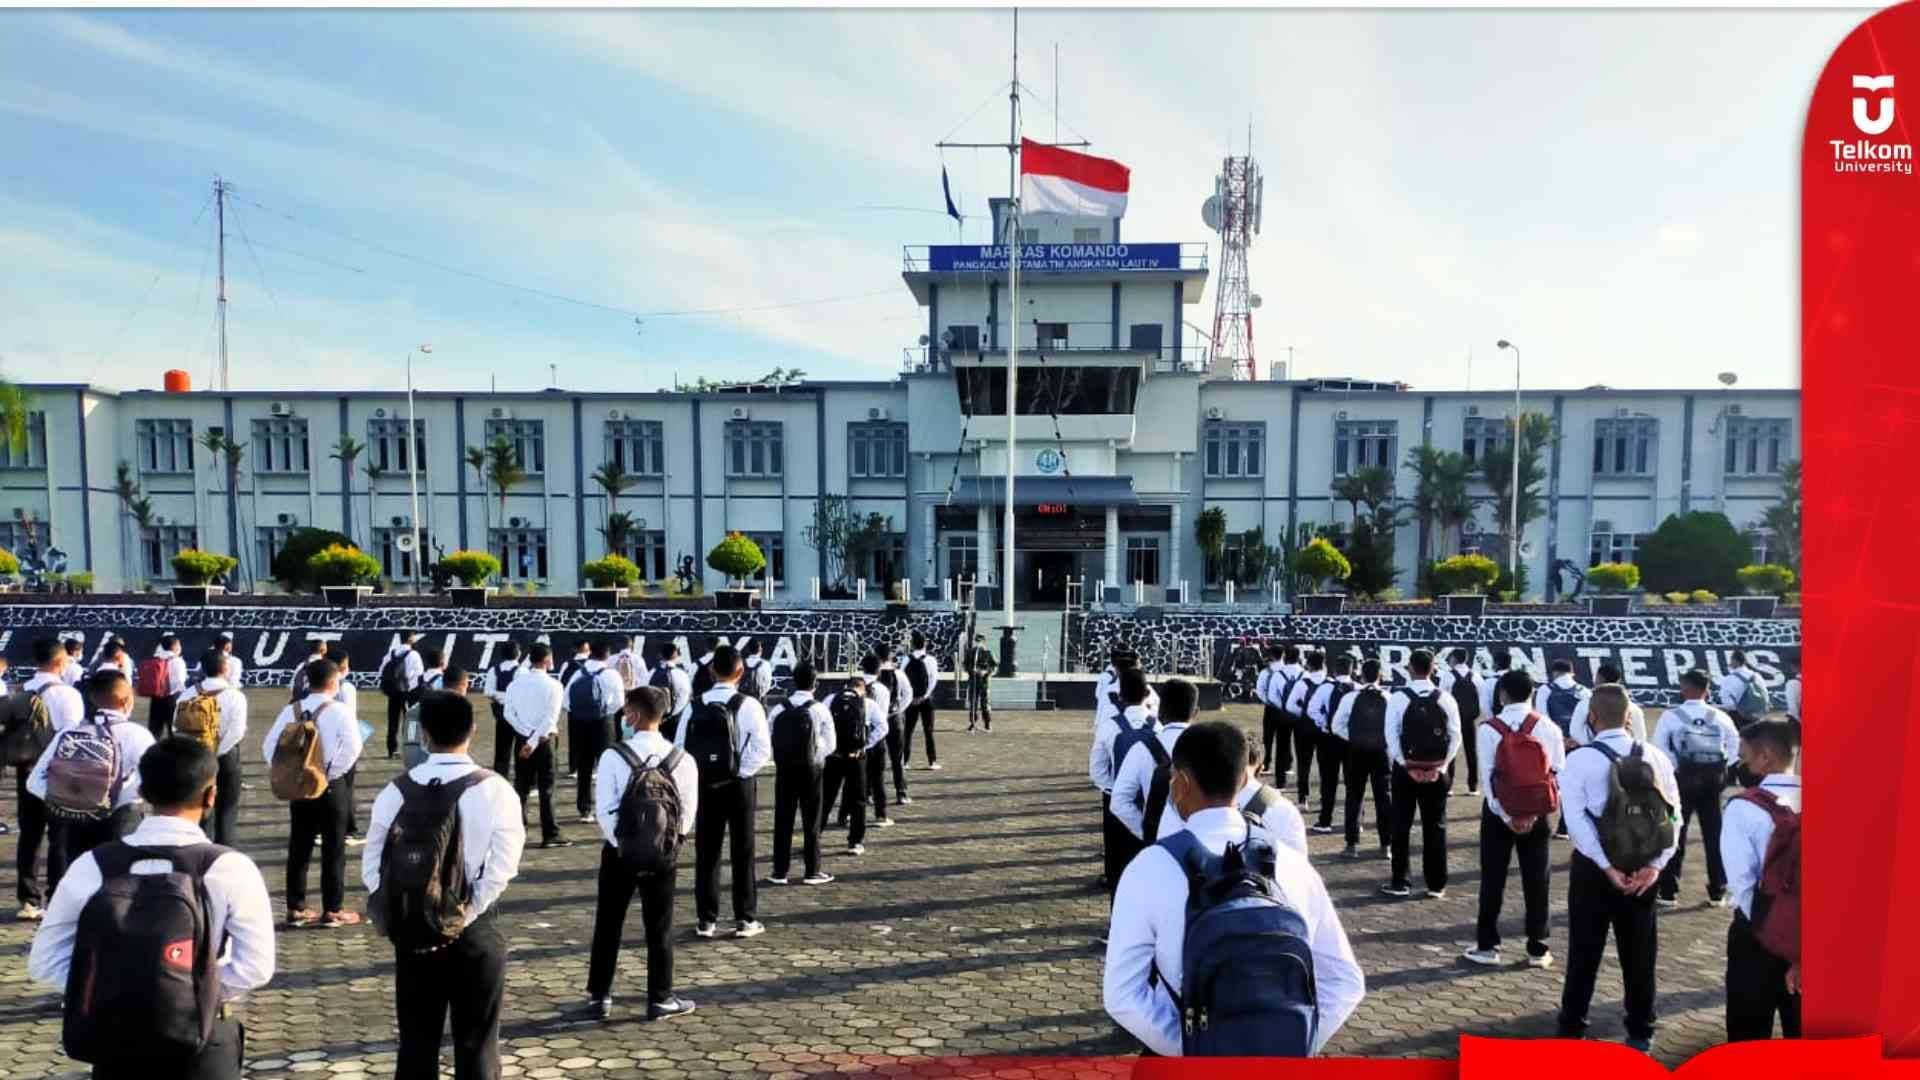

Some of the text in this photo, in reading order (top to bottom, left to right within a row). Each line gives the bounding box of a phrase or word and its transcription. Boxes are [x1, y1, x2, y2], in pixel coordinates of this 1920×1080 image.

[980, 244, 1129, 259] MARKAS KOMANDO
[953, 260, 1012, 270] PANGKALA
[1067, 259, 1119, 268] ANGKATAN
[1121, 259, 1148, 268] LAUT
[1149, 259, 1160, 268] IV
